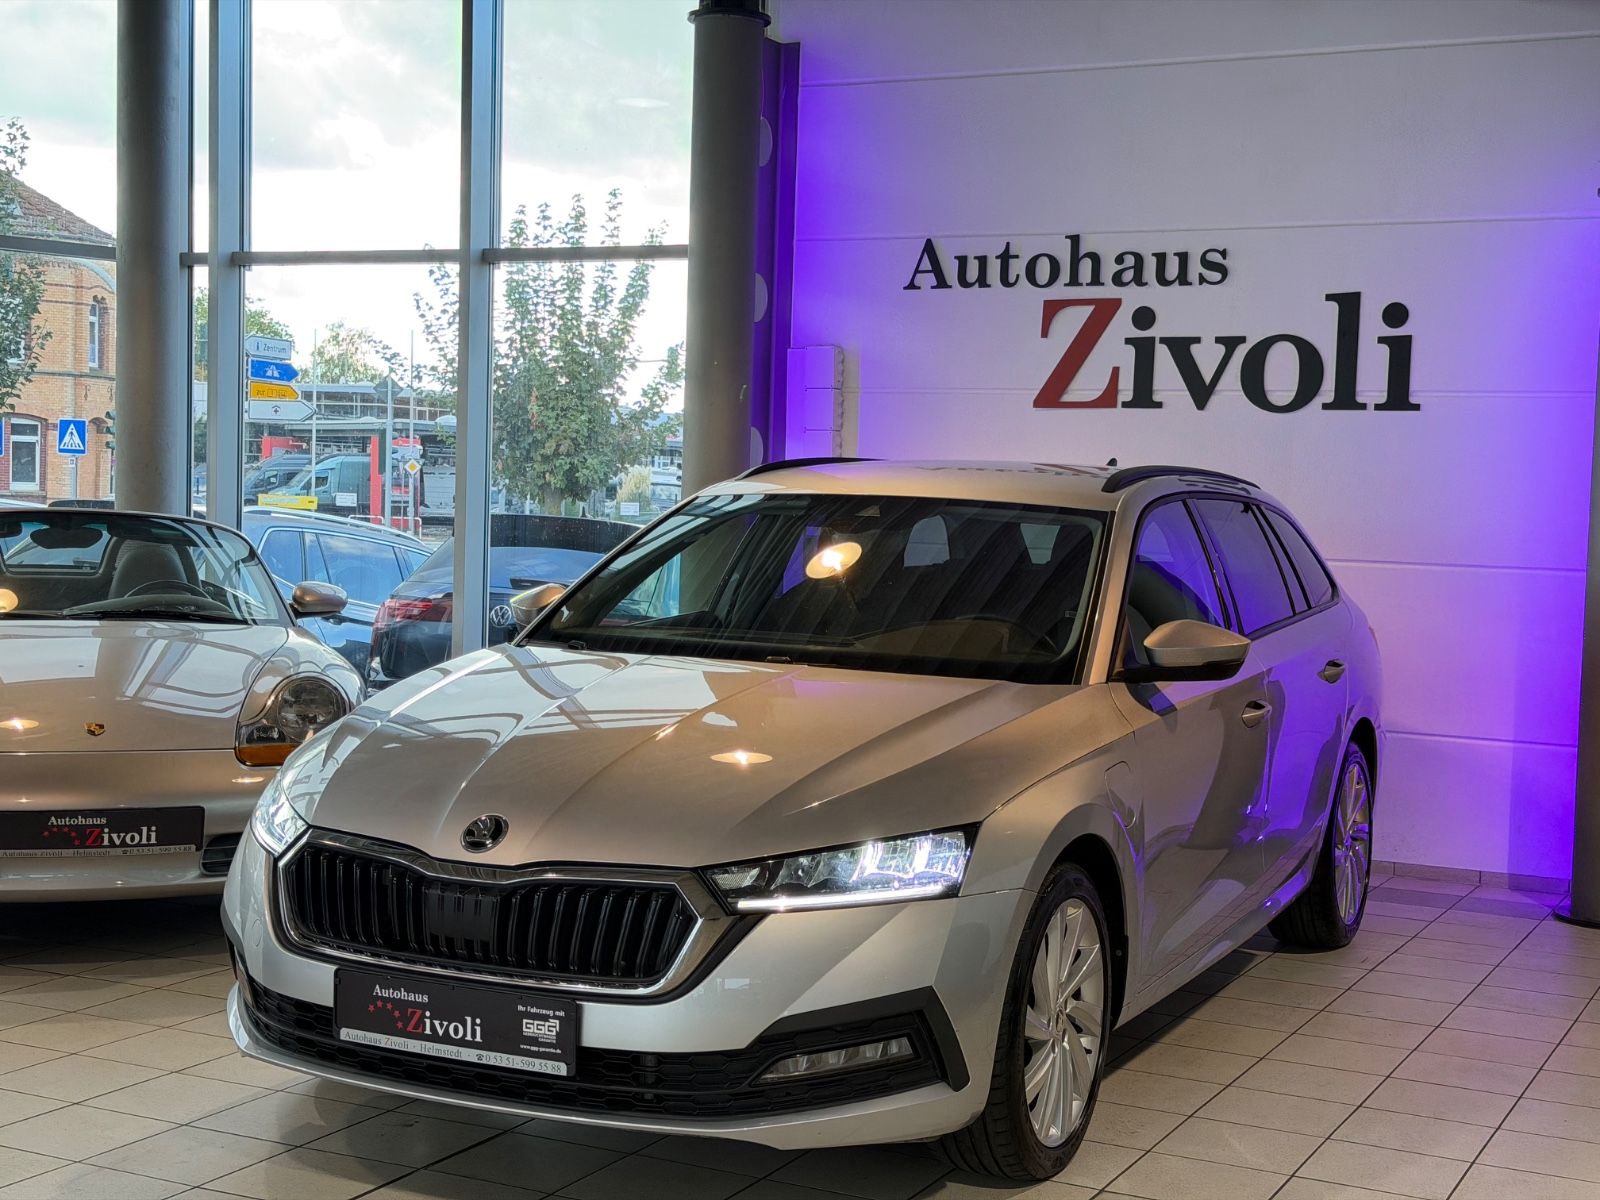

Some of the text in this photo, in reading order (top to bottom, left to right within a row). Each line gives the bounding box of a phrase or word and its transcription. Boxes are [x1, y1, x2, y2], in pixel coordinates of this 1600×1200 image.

[903, 234, 1229, 291] Autohaus
[263, 343, 287, 353] Zentrum
[1033, 291, 1421, 414] Zivoli
[48, 815, 107, 826] Autohaus
[85, 826, 158, 846] Zivoli
[373, 984, 429, 1003] Autohaus
[527, 1005, 554, 1017] Fahrzeug
[407, 1008, 483, 1043] Zivoli
[522, 1018, 559, 1036] GGG
[344, 1031, 382, 1045] Autohaus
[384, 1037, 409, 1050] Zivoli
[420, 1043, 463, 1058] Helmstedt
[493, 1055, 503, 1064] 53
[538, 1061, 549, 1071] 55
[551, 1063, 562, 1073] 88
